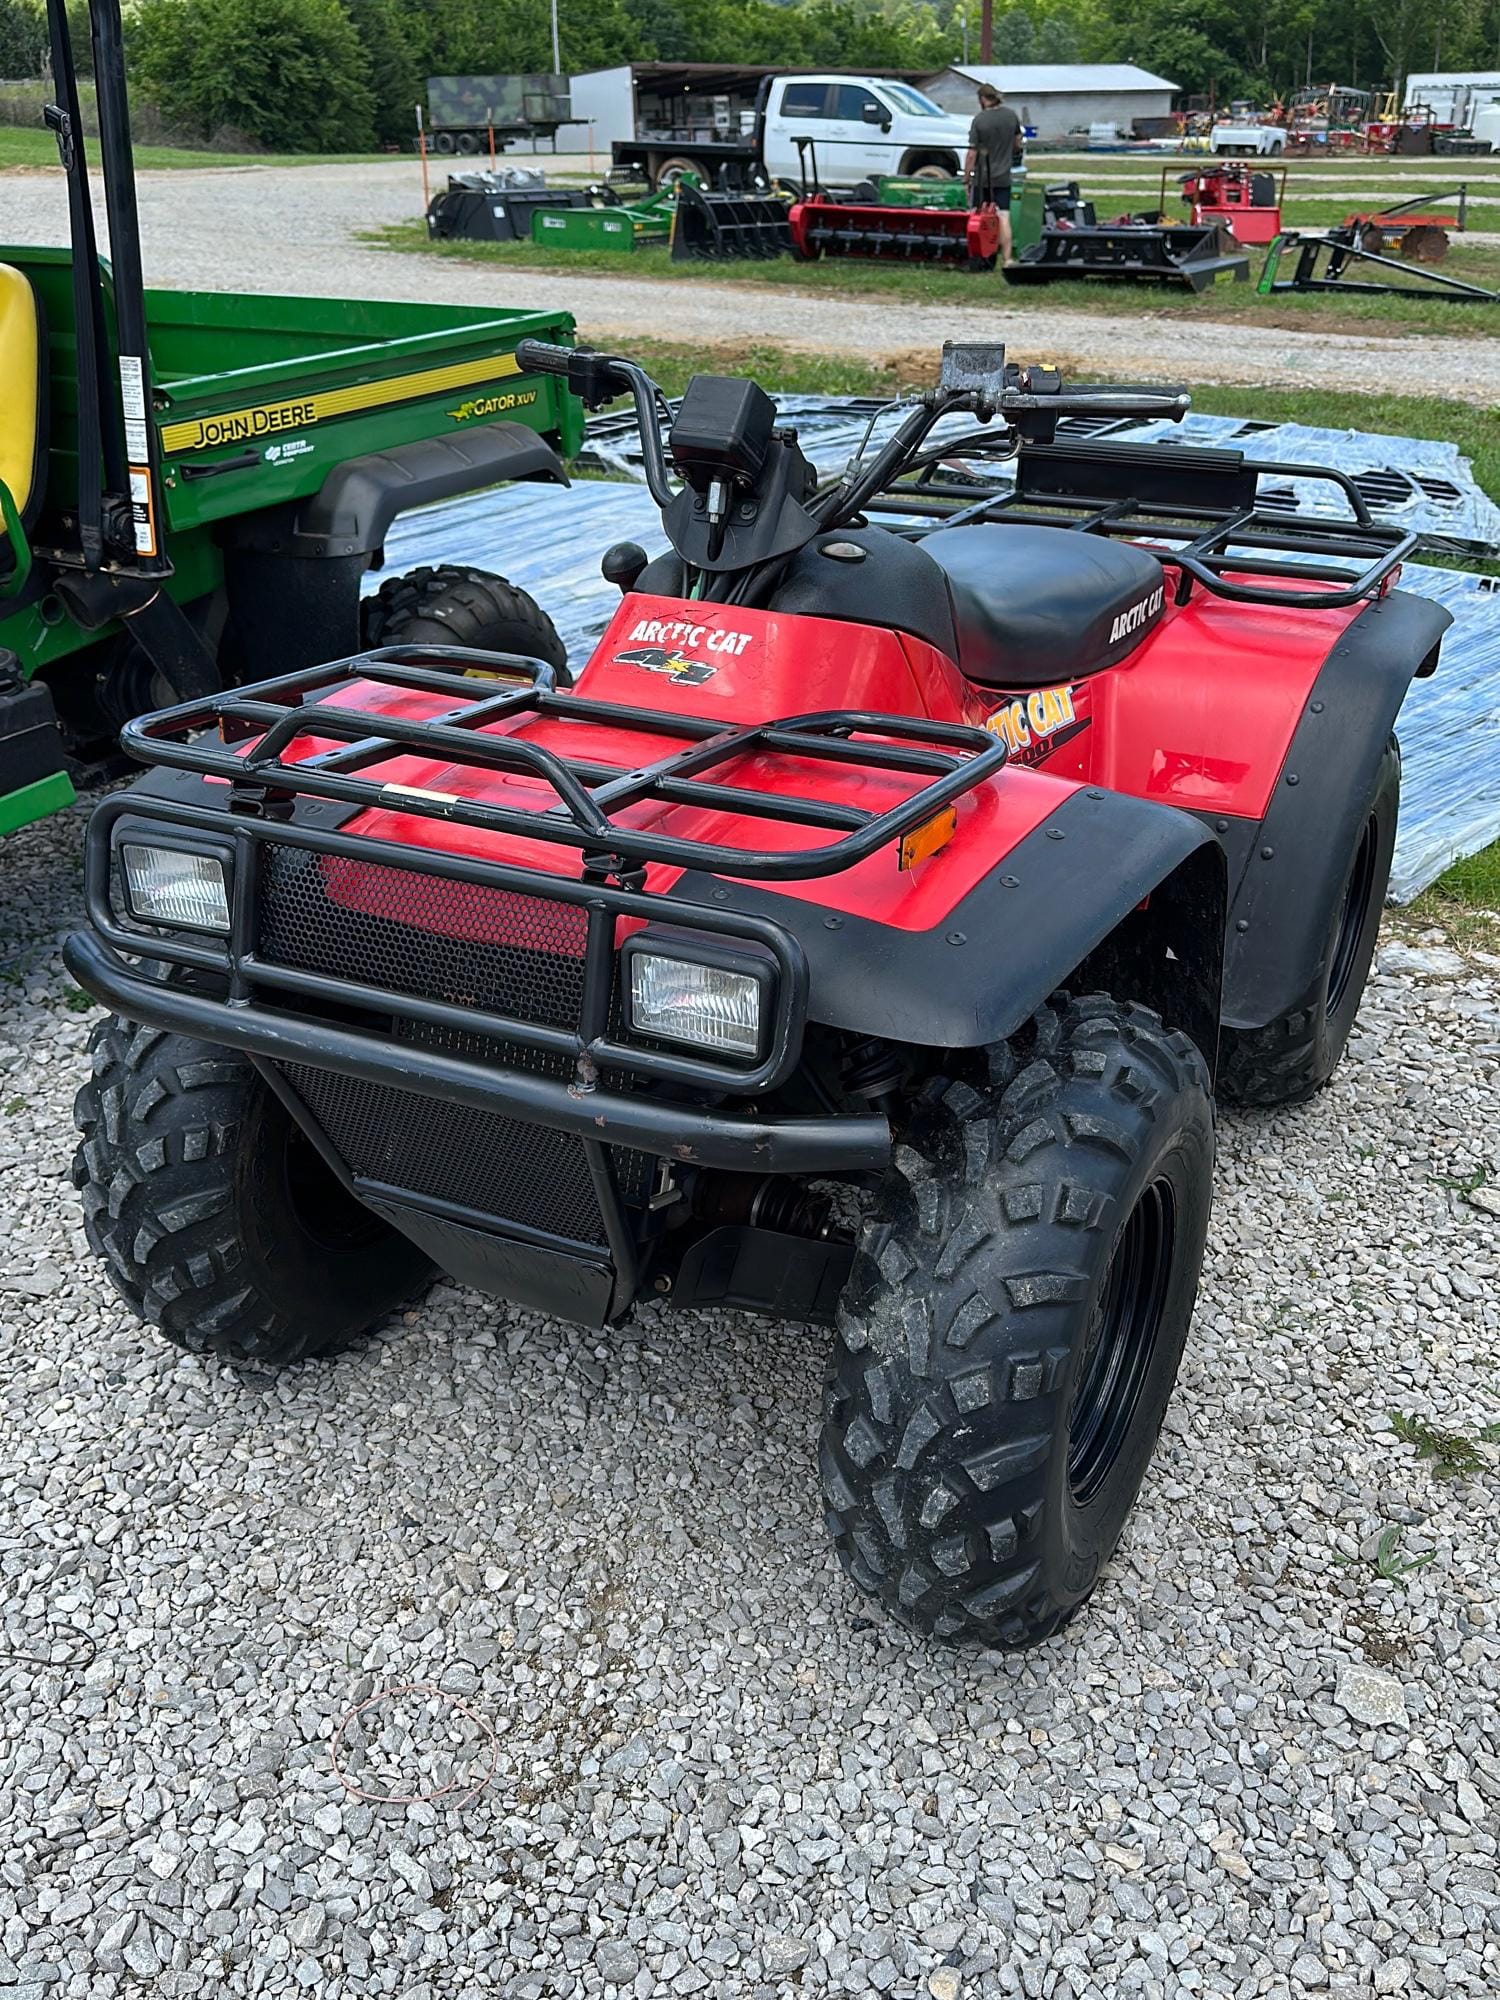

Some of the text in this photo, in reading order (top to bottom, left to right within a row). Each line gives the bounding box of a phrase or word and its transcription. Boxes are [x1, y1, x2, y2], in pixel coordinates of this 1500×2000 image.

[194, 402, 316, 446] JOHN DEERE
[474, 391, 536, 416] GATOR XUV
[1109, 585, 1164, 644] ARCTIC CAT
[628, 620, 753, 656] ARCTIC CAT
[1027, 686, 1076, 738] CAT
